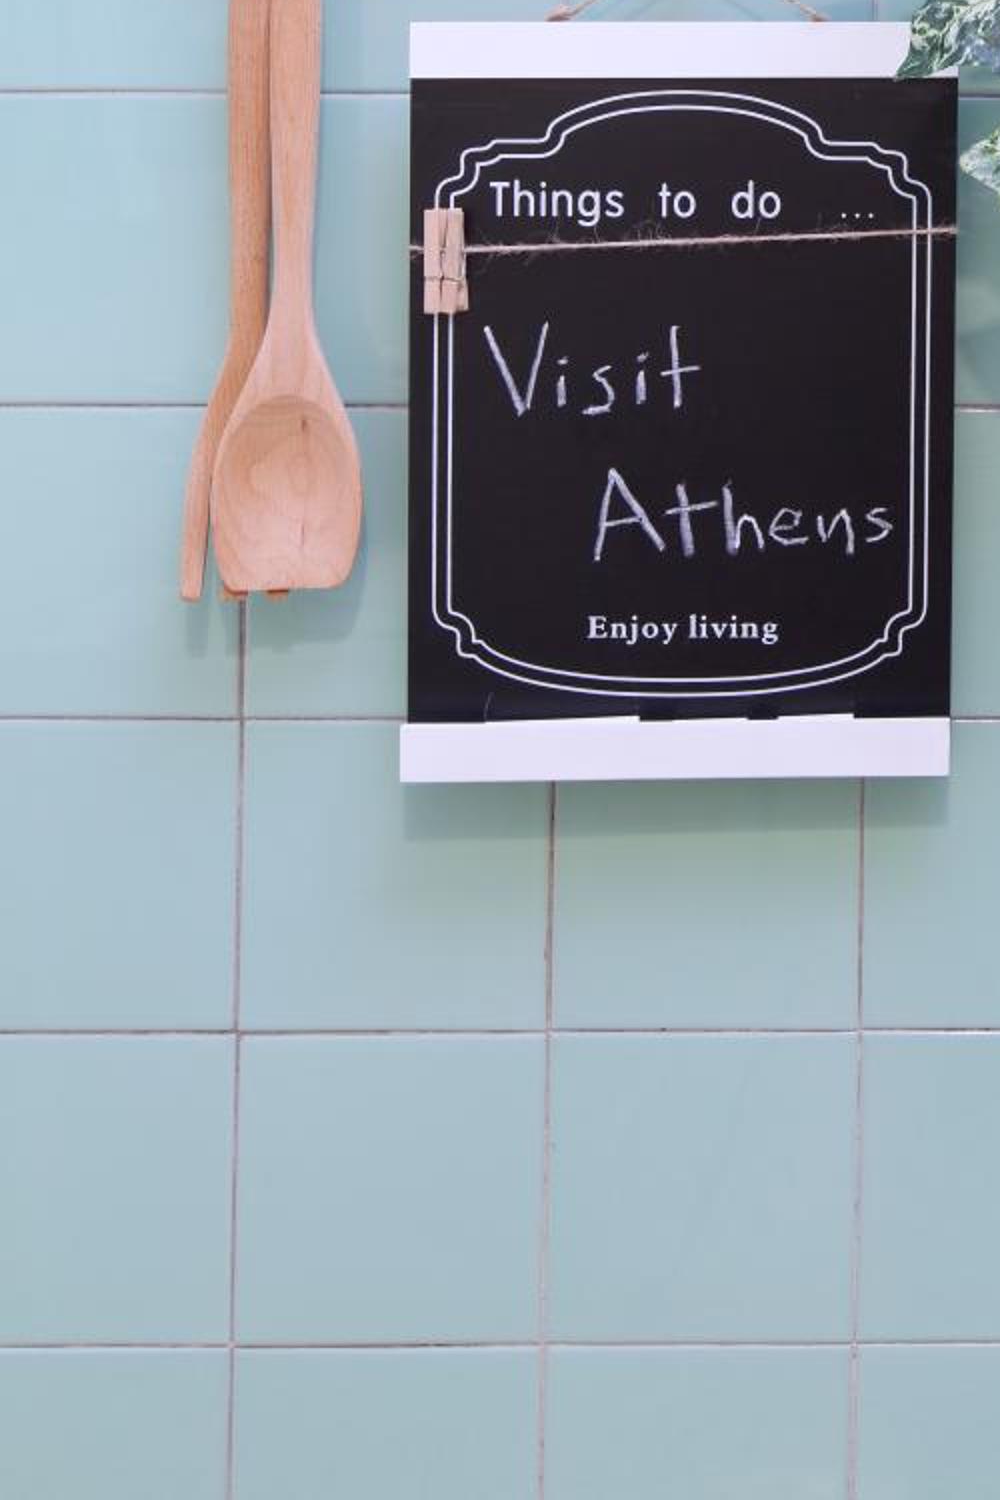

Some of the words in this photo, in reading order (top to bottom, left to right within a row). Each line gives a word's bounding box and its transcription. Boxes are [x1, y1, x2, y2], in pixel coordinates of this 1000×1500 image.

[489, 179, 625, 228] Things
[657, 182, 697, 219] to
[731, 179, 782, 219] do
[483, 321, 701, 417] Visit
[593, 467, 894, 562] Athens
[587, 614, 678, 646] Enjoy
[688, 613, 779, 645] living
